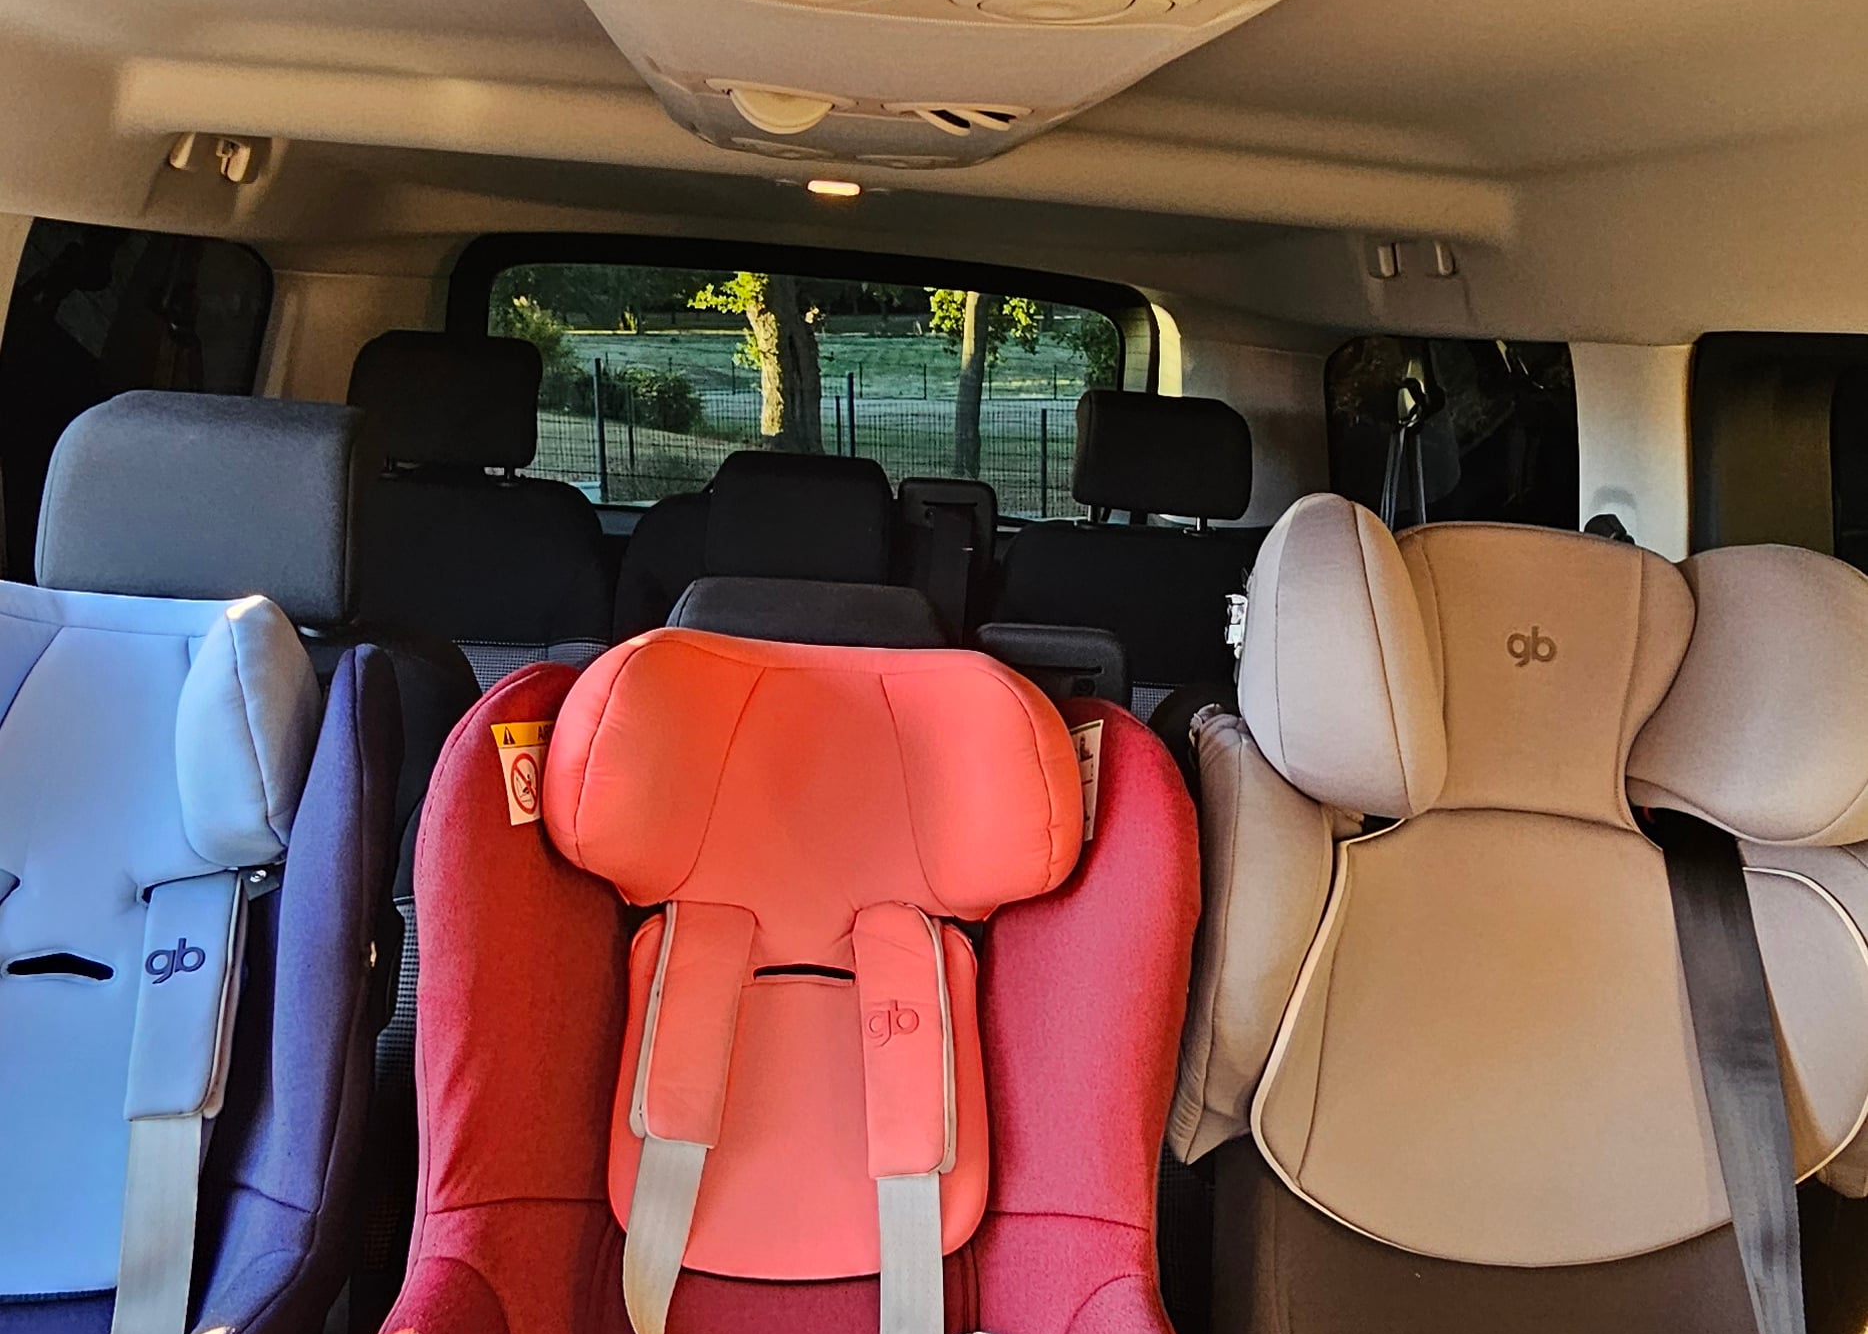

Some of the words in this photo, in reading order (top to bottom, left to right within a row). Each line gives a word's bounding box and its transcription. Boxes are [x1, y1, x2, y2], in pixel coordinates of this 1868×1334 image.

[1507, 626, 1557, 667] gb
[145, 937, 206, 984] gb
[865, 1000, 919, 1047] gb
